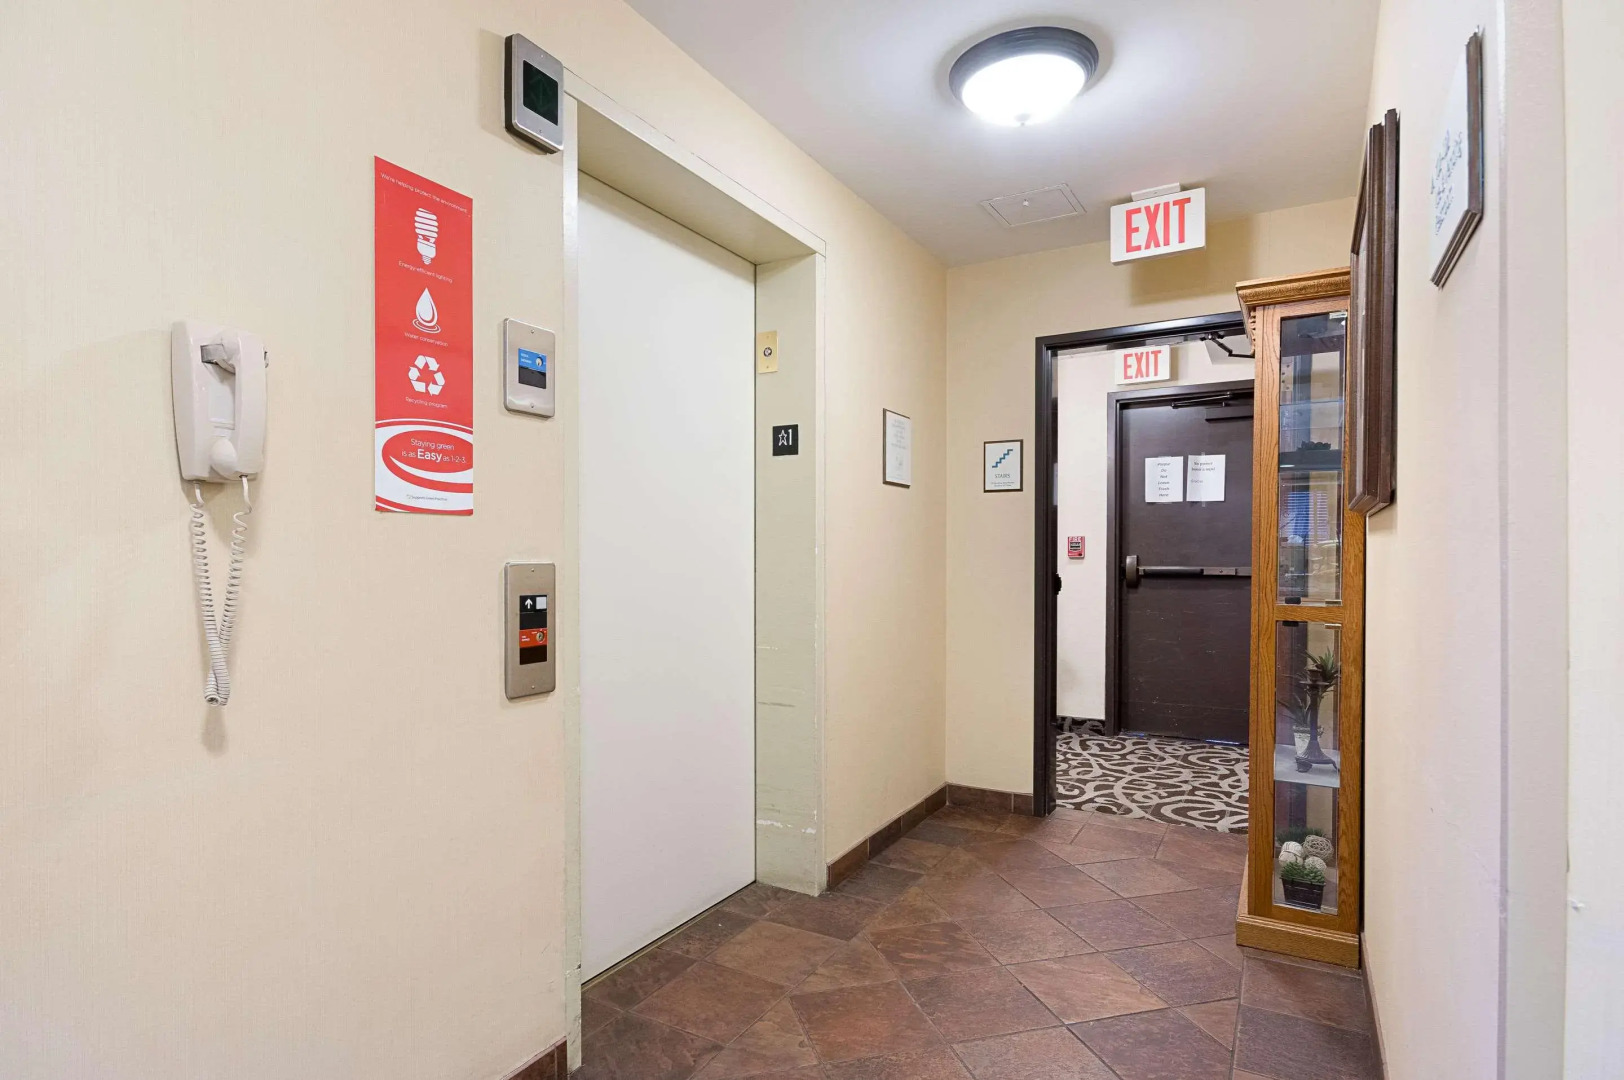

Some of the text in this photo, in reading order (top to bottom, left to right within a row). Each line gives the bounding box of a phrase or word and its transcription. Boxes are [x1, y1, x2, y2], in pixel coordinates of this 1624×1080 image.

[396, 179, 414, 191] helping
[415, 187, 431, 199] protect
[1125, 197, 1191, 254] EXIT
[404, 332, 448, 347] Water conservation
[1123, 350, 1162, 380] EXIT
[405, 396, 428, 406] Recycling
[411, 438, 455, 451] Staying green
[401, 449, 407, 457] is
[417, 448, 442, 462] Easy
